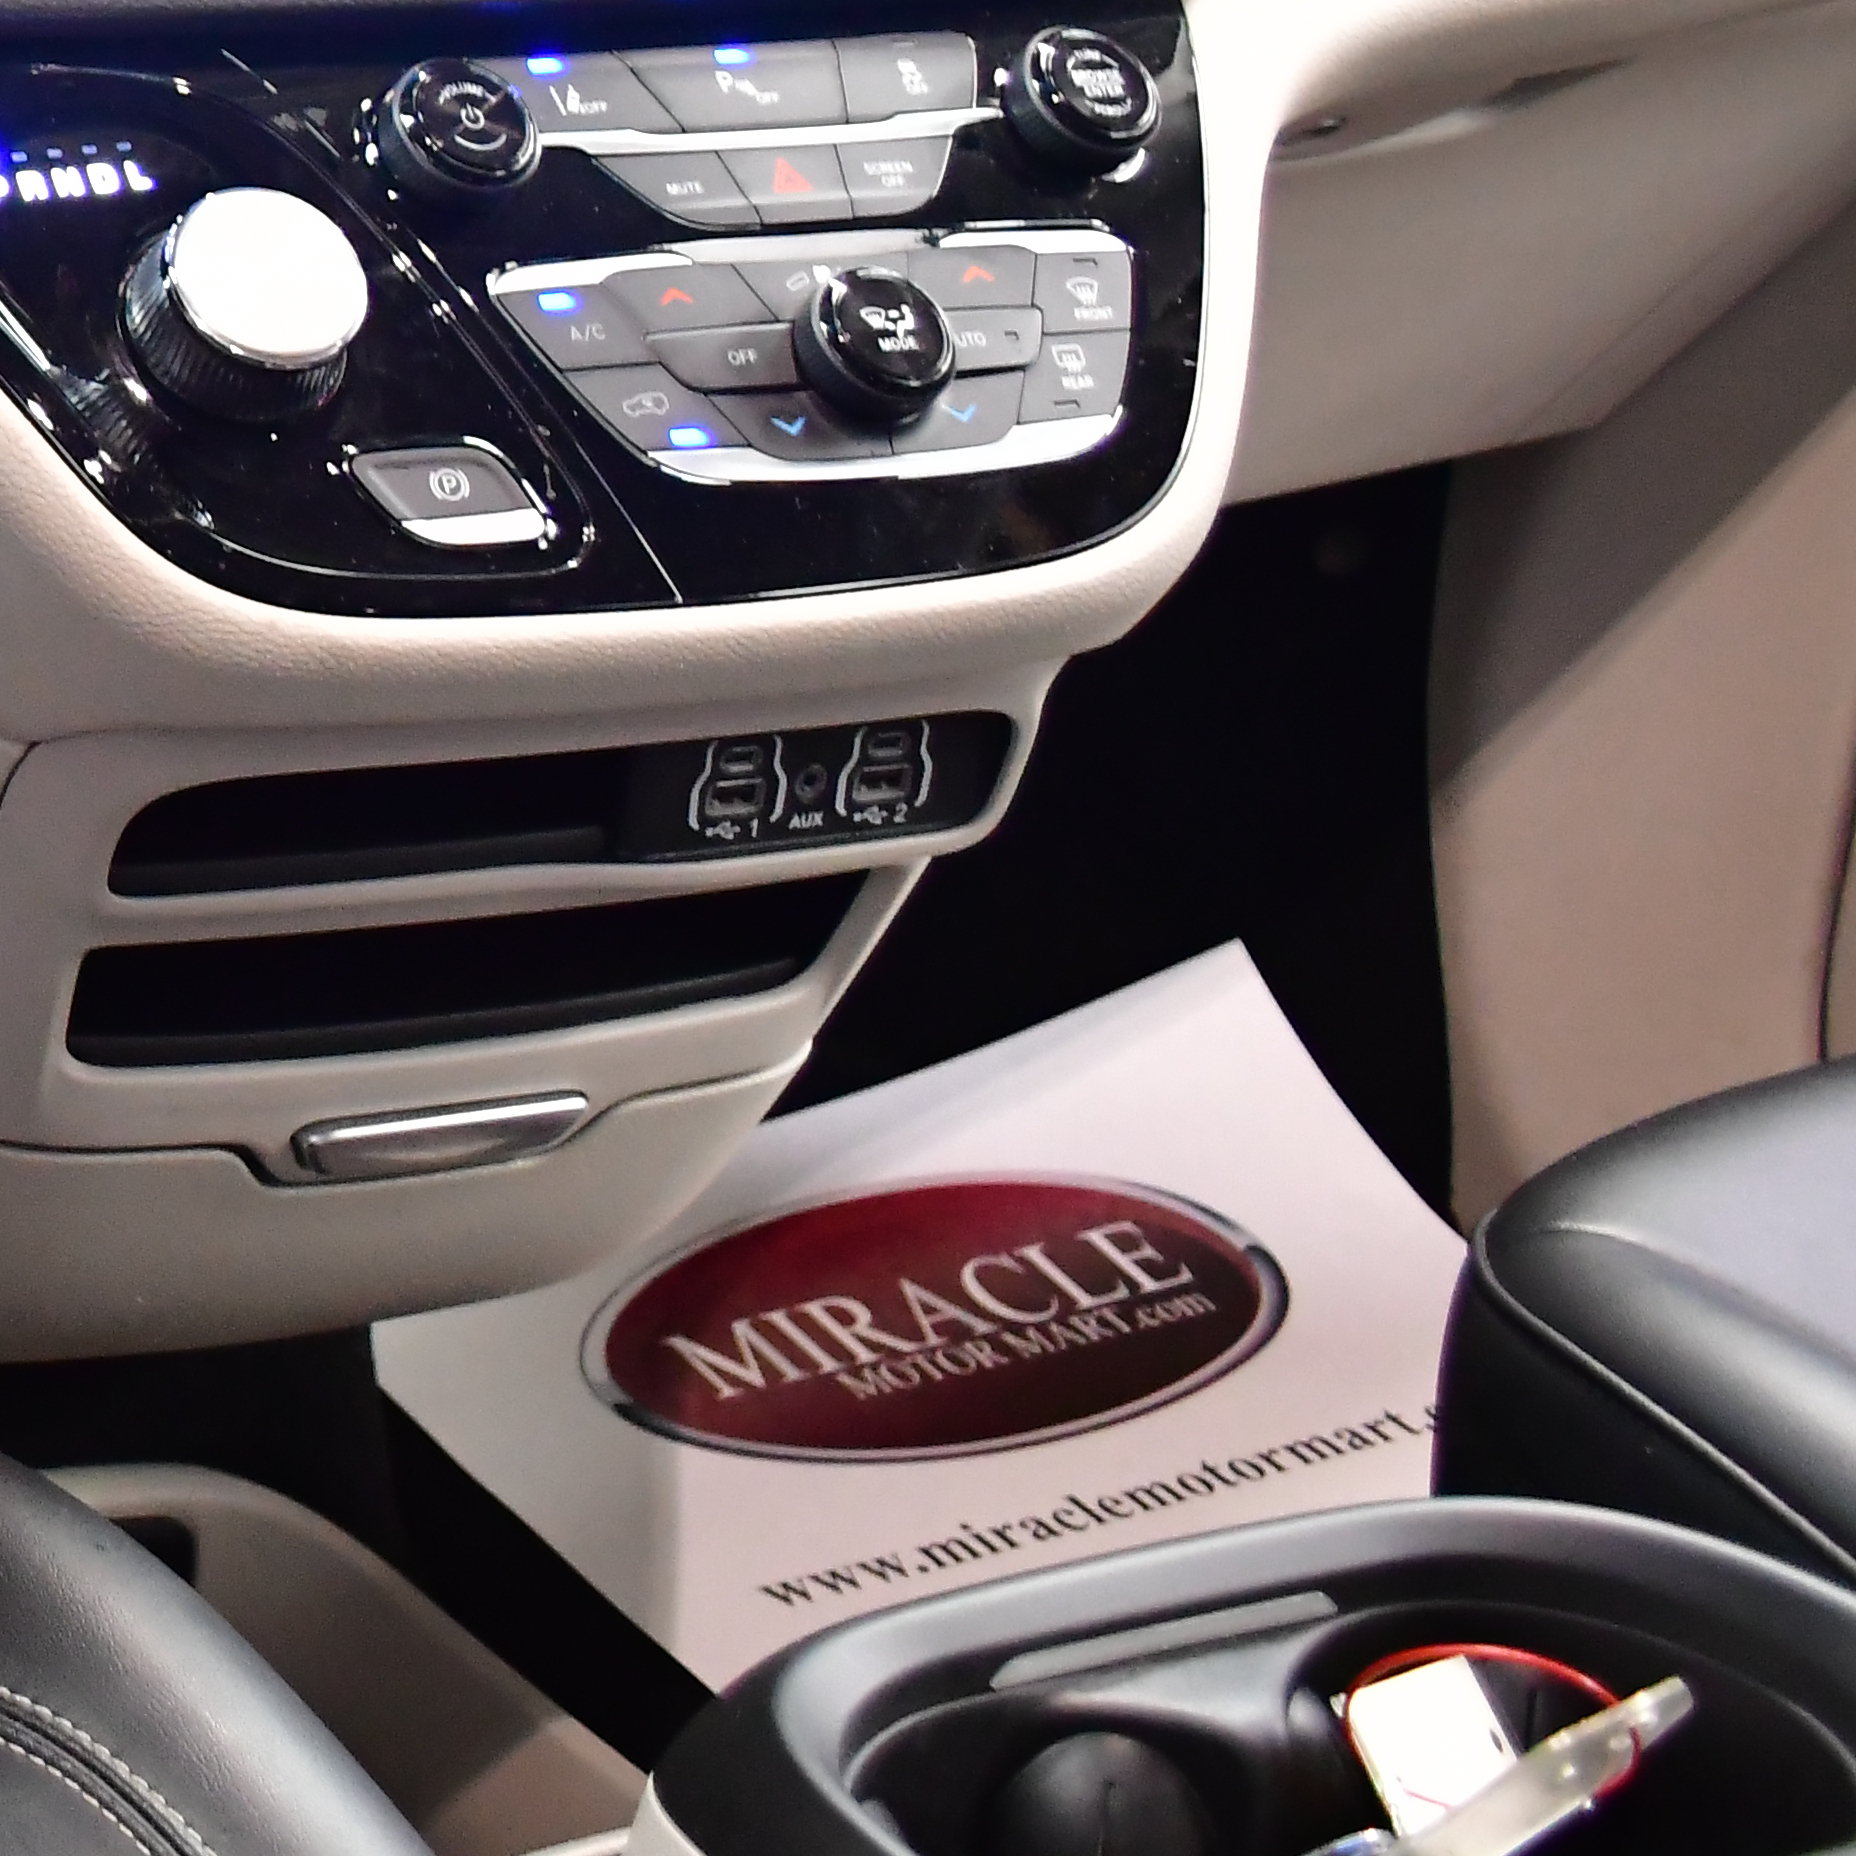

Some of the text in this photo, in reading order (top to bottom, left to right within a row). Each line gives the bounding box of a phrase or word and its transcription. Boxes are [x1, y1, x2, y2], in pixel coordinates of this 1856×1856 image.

[570, 322, 606, 342] A/C
[954, 330, 987, 348] UTO
[727, 347, 758, 365] OFF
[788, 811, 824, 830] AUX
[666, 1218, 1194, 1400] MIRACLE
[835, 1334, 1008, 1400] MOTOR
